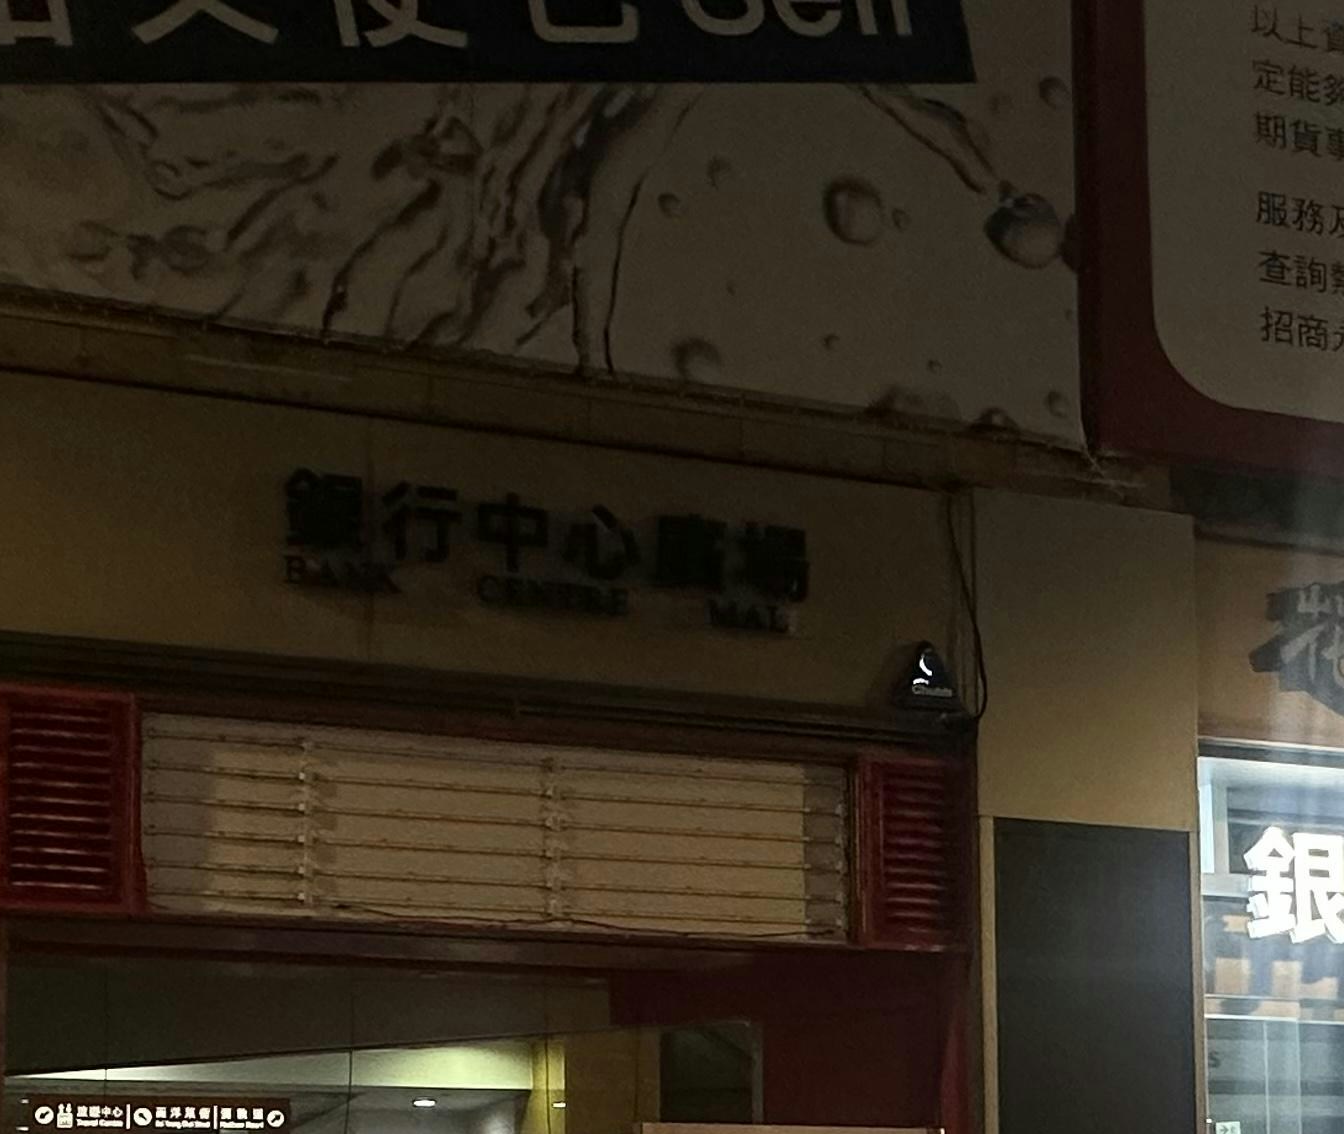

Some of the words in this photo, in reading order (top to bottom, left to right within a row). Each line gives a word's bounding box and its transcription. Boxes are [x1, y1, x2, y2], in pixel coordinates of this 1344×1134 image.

[284, 466, 810, 600] 銀行中心廣場
